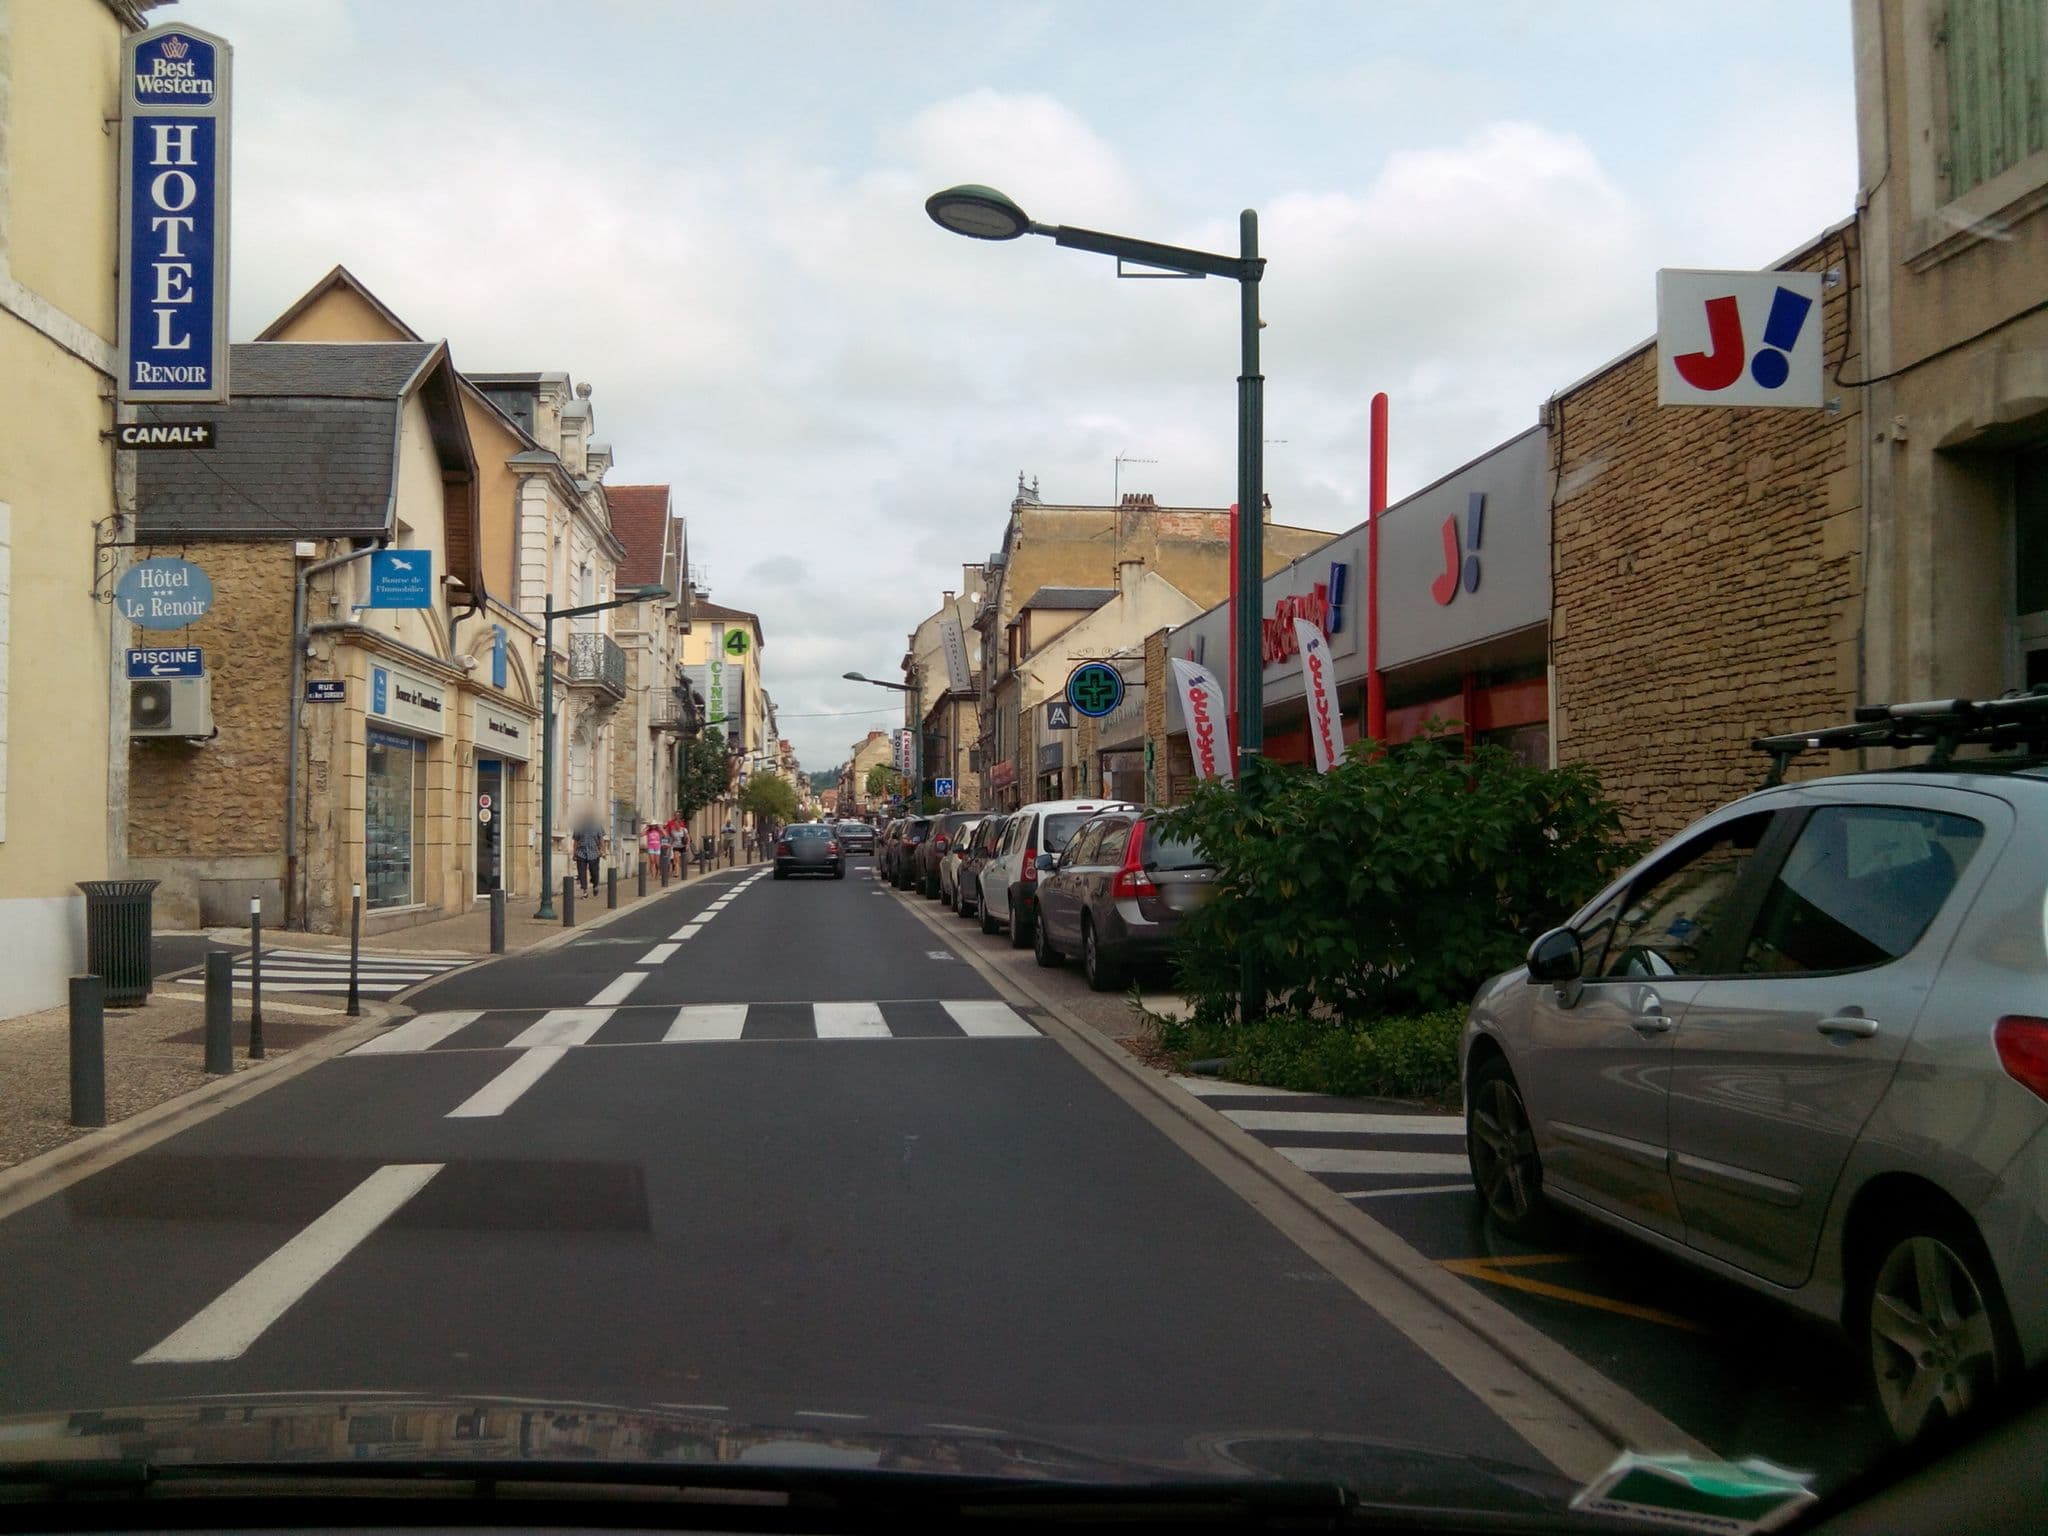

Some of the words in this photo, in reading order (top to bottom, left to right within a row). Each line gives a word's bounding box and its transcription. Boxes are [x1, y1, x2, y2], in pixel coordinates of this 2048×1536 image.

[152, 58, 195, 77] Best
[136, 74, 213, 93] Western
[149, 124, 198, 350] HOTEL
[1673, 286, 1813, 391] J!
[135, 361, 206, 383] RENOIR
[122, 426, 208, 443] CANAL+
[1431, 492, 1485, 606] J!
[140, 567, 189, 588] Hôtel
[126, 599, 145, 618] Le
[151, 596, 205, 617] Renoir
[727, 631, 747, 653] 4
[132, 651, 197, 664] PISCINE
